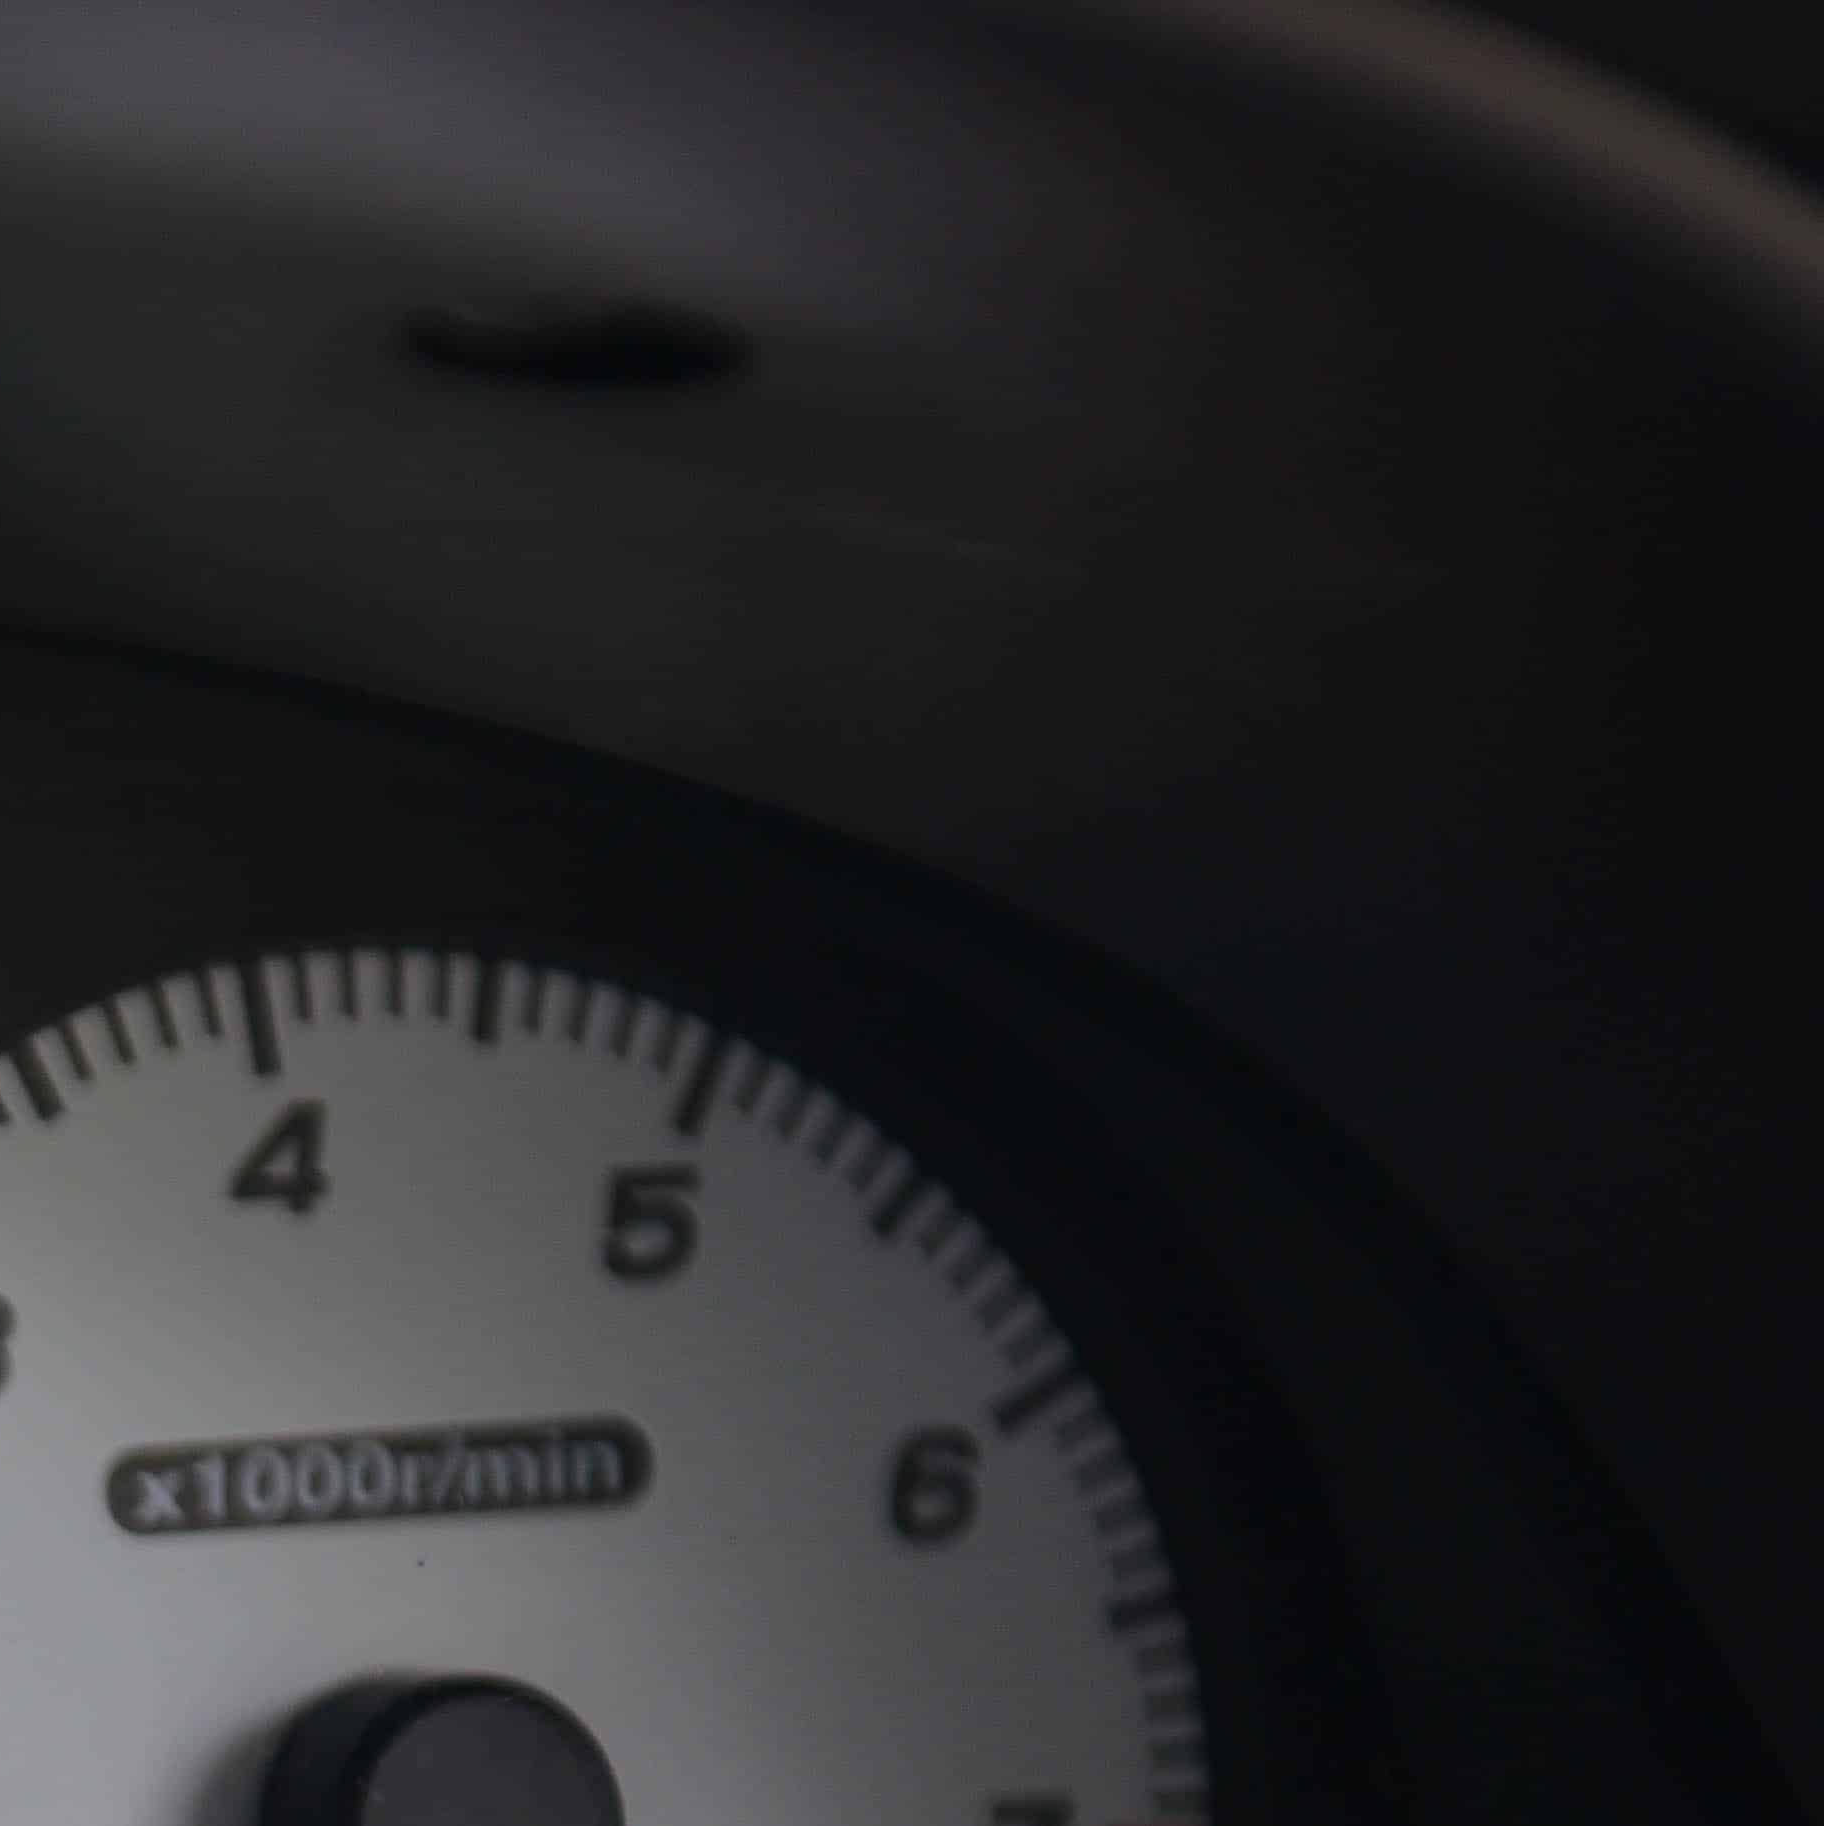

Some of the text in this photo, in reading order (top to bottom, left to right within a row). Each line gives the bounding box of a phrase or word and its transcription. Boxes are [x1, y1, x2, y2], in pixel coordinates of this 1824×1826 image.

[230, 1101, 327, 1215] 4
[603, 1166, 697, 1281] 5
[133, 1432, 623, 1528] x1000r/min
[888, 1429, 977, 1544] 6
